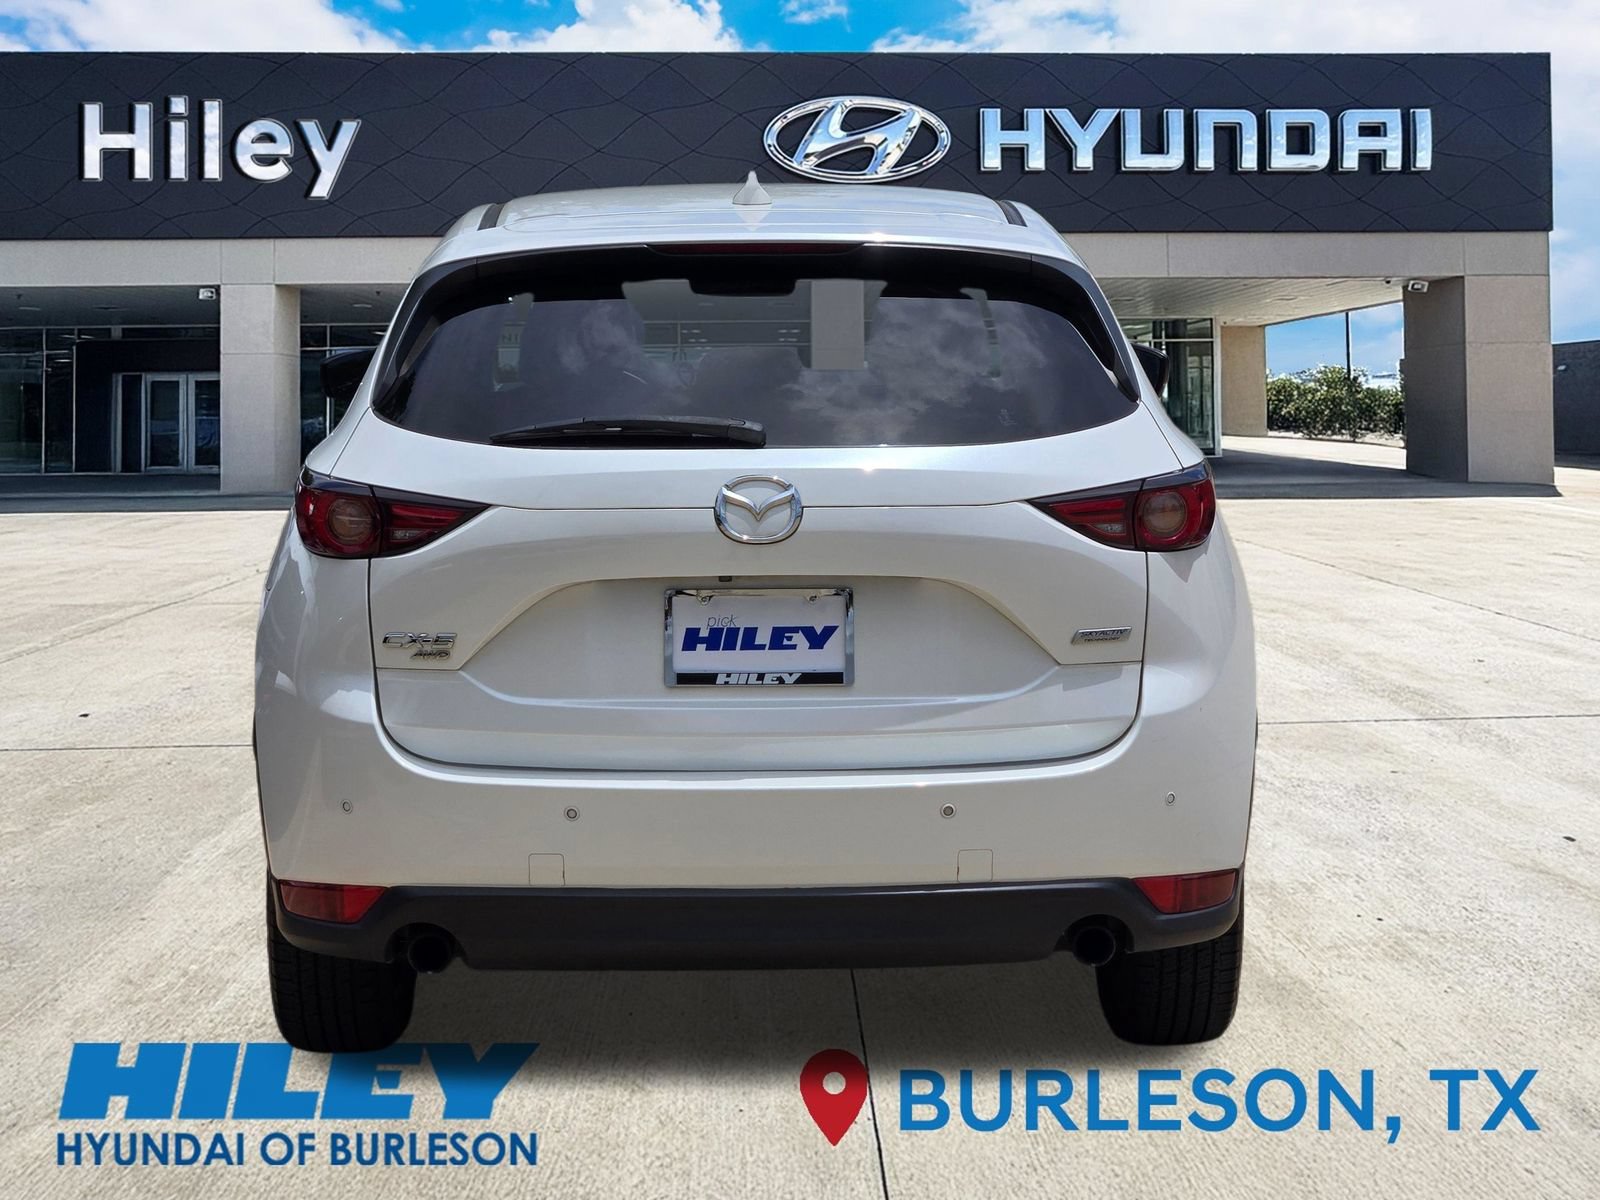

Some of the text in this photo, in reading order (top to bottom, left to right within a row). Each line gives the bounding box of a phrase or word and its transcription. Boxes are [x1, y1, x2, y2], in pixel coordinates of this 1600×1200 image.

[79, 95, 361, 200] Hiley
[979, 107, 1433, 172] HYUNDAI
[707, 614, 737, 630] pick
[382, 631, 457, 649] CX-5
[682, 625, 839, 652] HILEY
[410, 650, 451, 660] AWD
[716, 672, 802, 685] HILEY
